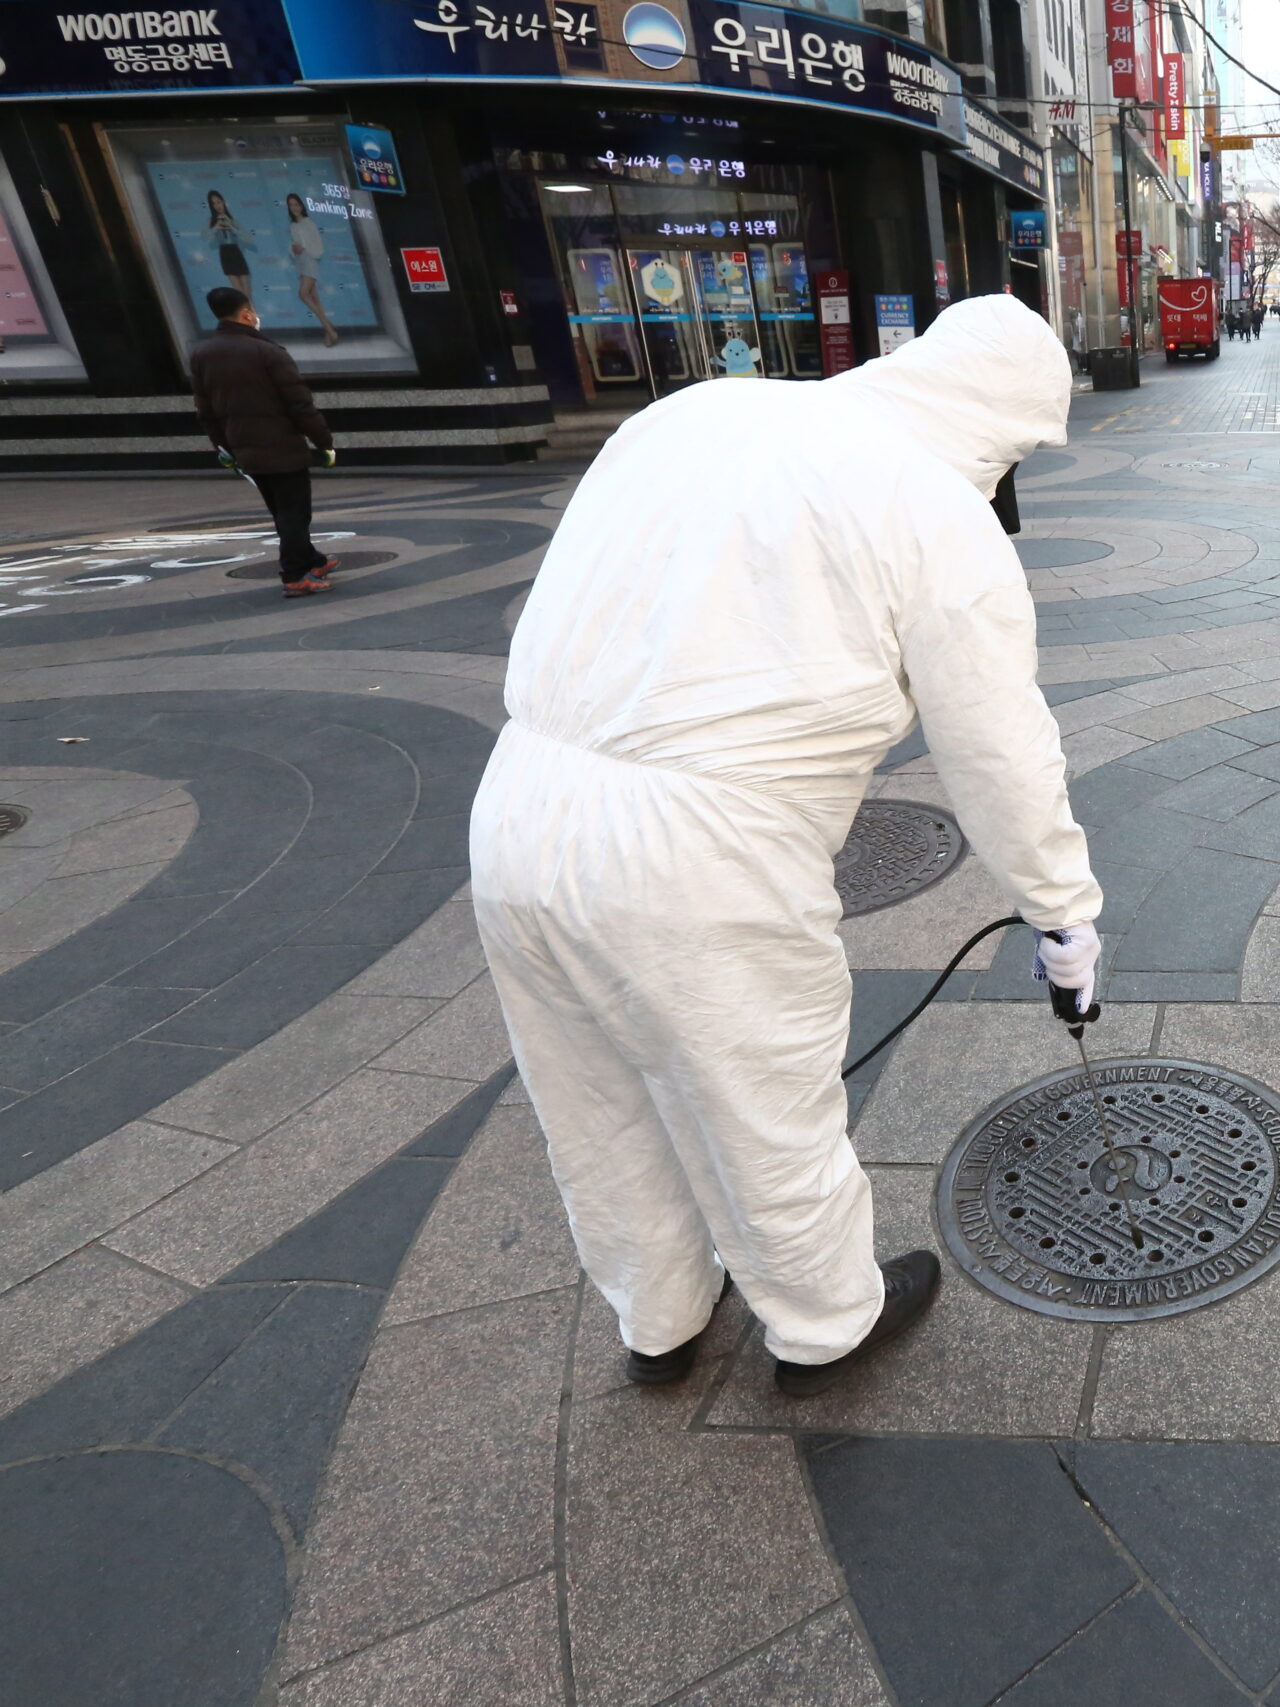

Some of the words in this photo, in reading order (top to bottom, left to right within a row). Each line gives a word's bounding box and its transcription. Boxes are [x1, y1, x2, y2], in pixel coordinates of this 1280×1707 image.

[413, 0, 597, 54] 우리나라
[104, 42, 233, 73] 명동금융센터
[711, 17, 866, 93] 우리은행
[1168, 62, 1178, 98] Pretty
[1169, 107, 1180, 131] skin
[359, 158, 394, 175] 우리은행
[306, 197, 349, 220] Banking
[349, 203, 374, 220] Zone
[410, 260, 438, 273] 에스원
[1045, 1067, 1175, 1102] GOVERNMENT
[1074, 1257, 1236, 1306] GOVERNMENT
